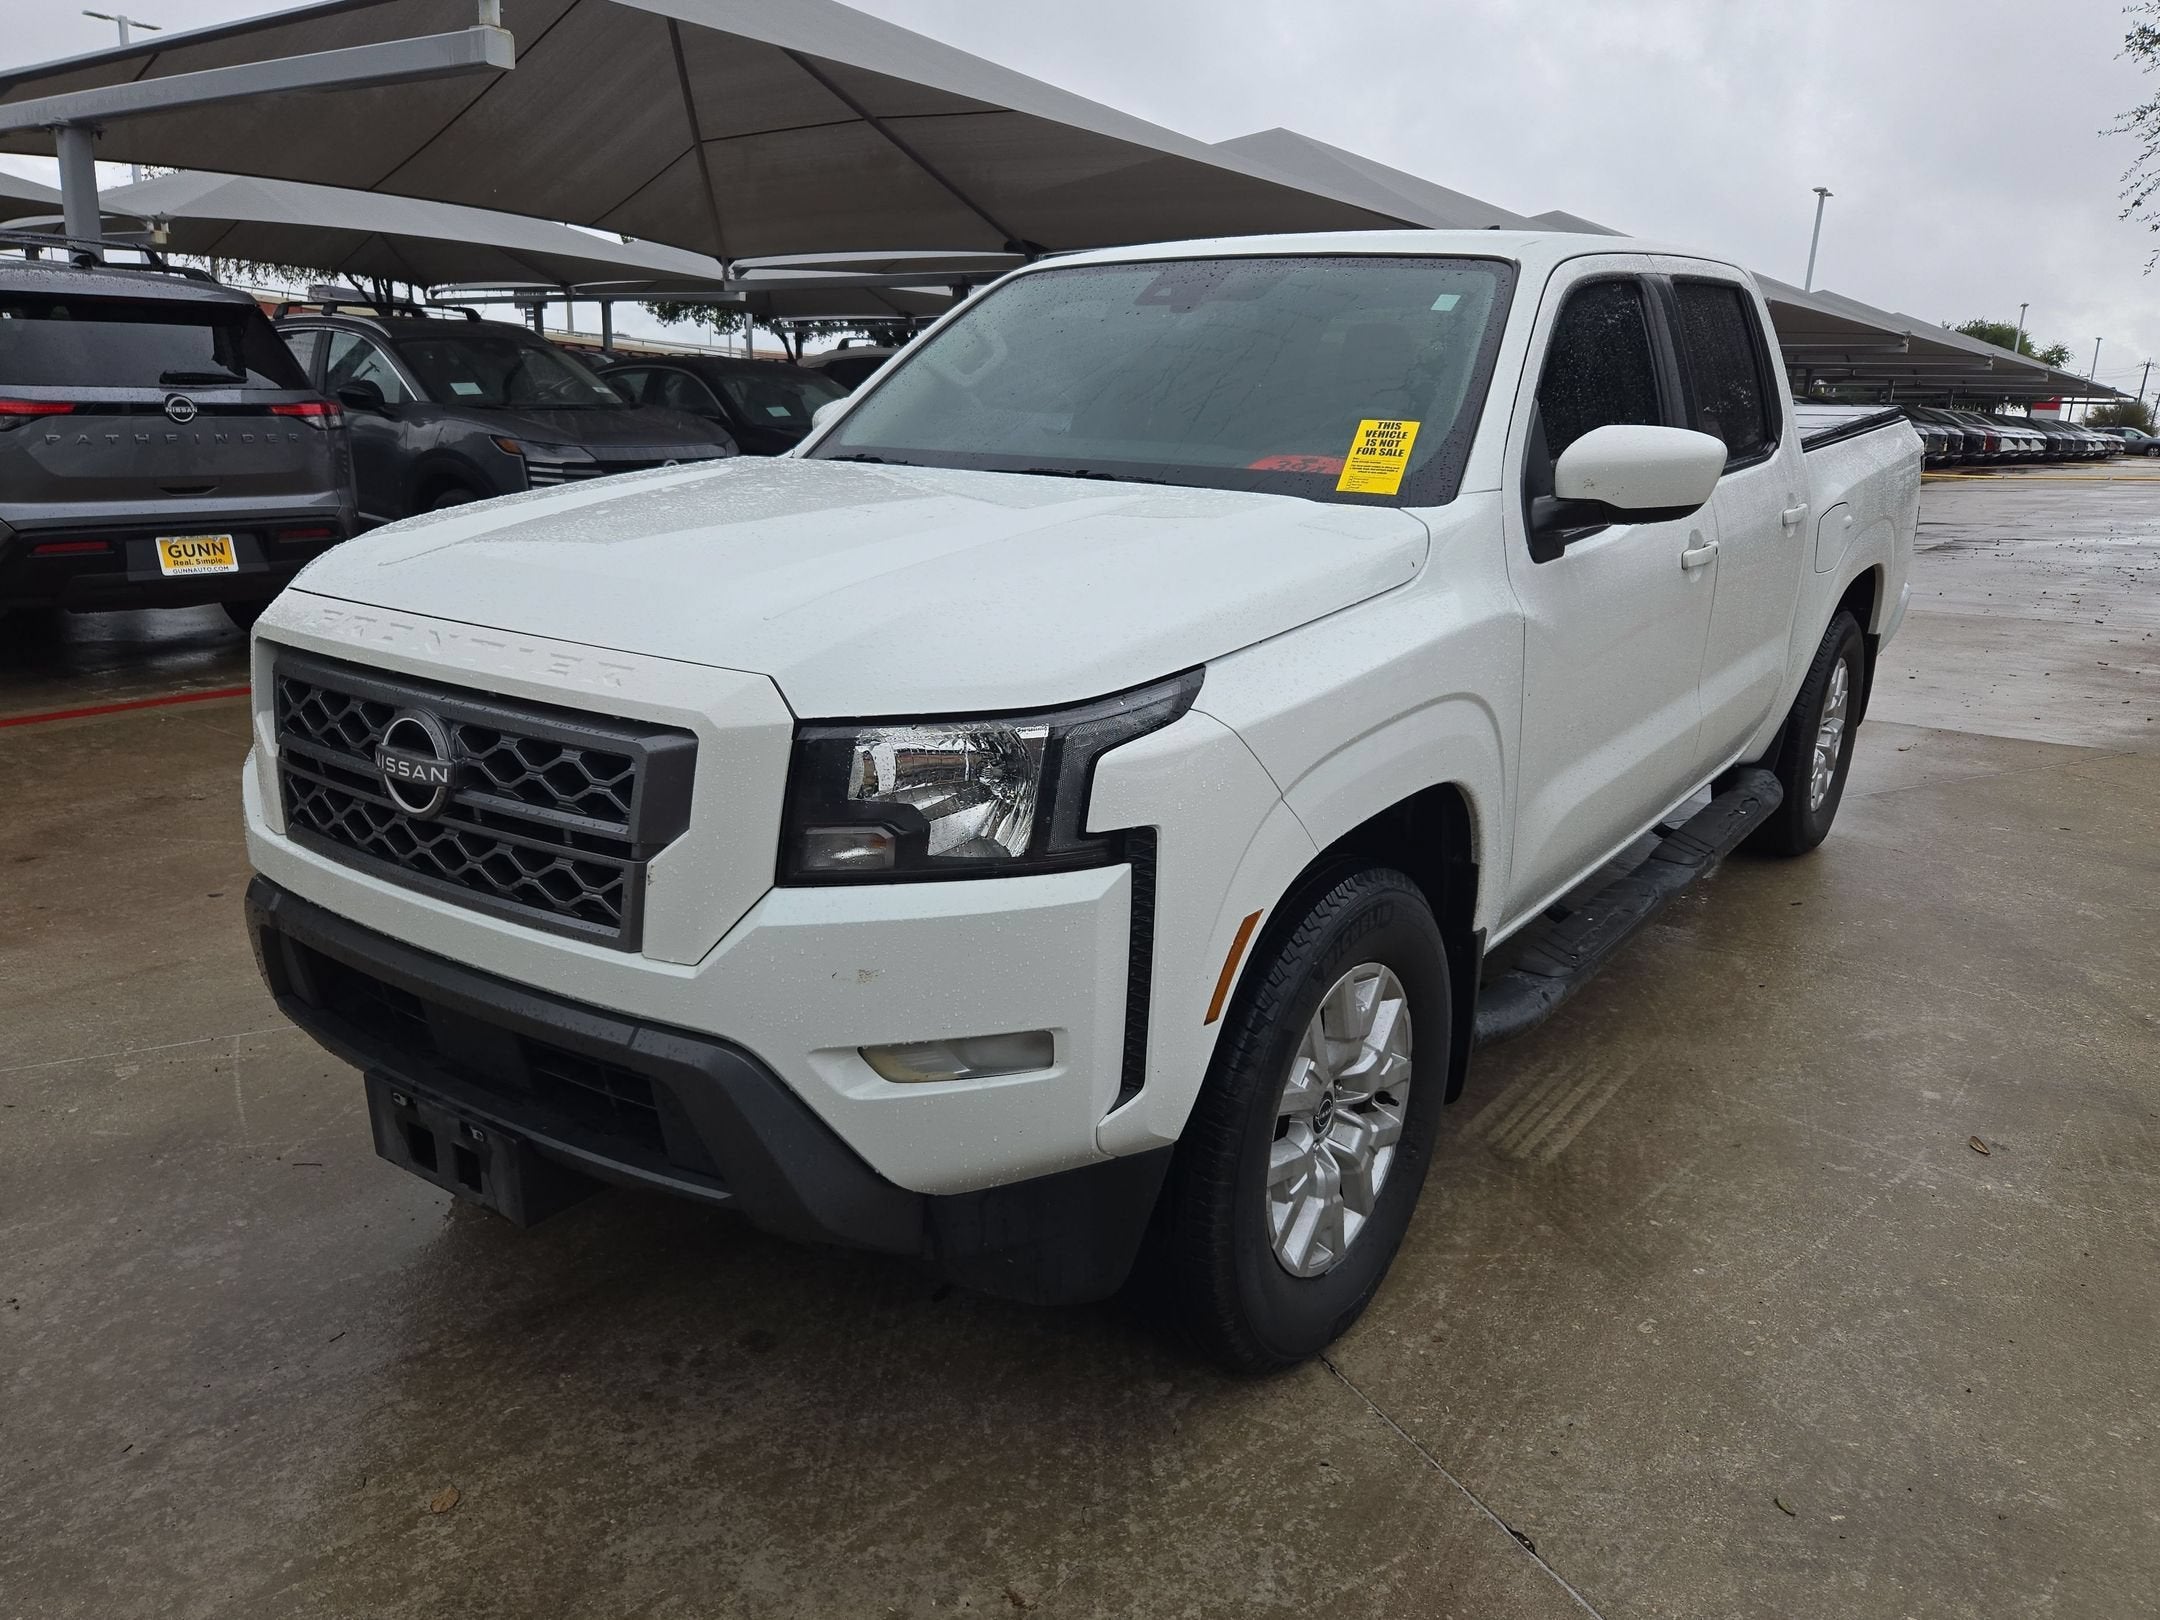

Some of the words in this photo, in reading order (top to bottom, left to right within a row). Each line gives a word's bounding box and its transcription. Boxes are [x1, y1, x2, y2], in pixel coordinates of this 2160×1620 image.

[1377, 421, 1402, 430] THIS
[44, 432, 299, 447] PATHFINDER
[1365, 430, 1409, 440] VEHICLE
[1365, 438, 1378, 447] IS
[1379, 440, 1402, 448] NOT
[1356, 447, 1377, 456] FOR
[1378, 448, 1405, 458] SALE
[167, 542, 226, 559] GUNN
[173, 559, 194, 567] Real.
[196, 557, 226, 566] Simple.
[374, 751, 448, 783] NISSAN
